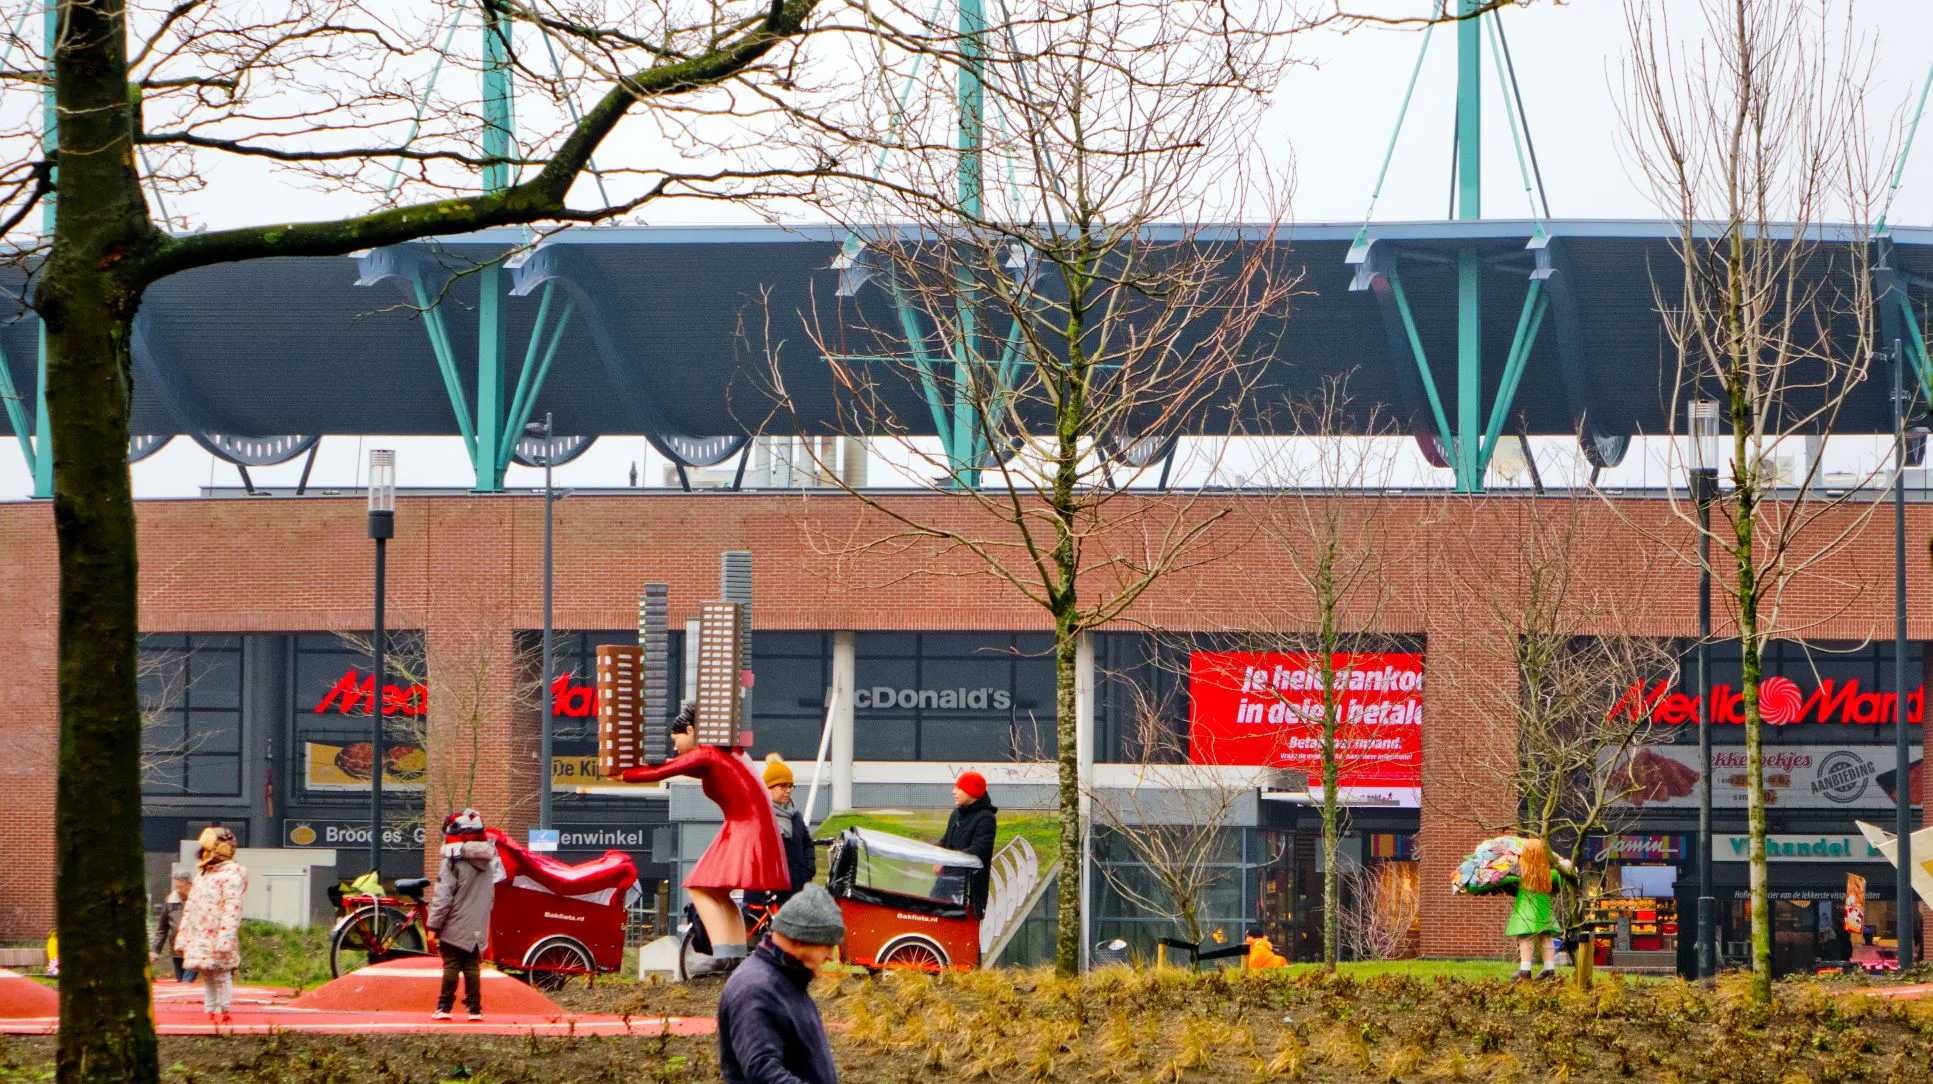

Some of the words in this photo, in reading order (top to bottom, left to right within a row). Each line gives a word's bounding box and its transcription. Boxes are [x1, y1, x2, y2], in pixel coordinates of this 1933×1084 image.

[1236, 698, 1264, 724] in
[1811, 761, 1876, 795] AANBIEDING
[326, 827, 402, 843] Brooes
[560, 830, 643, 845] enwinkel
[1729, 838, 1851, 857] Vihandel
